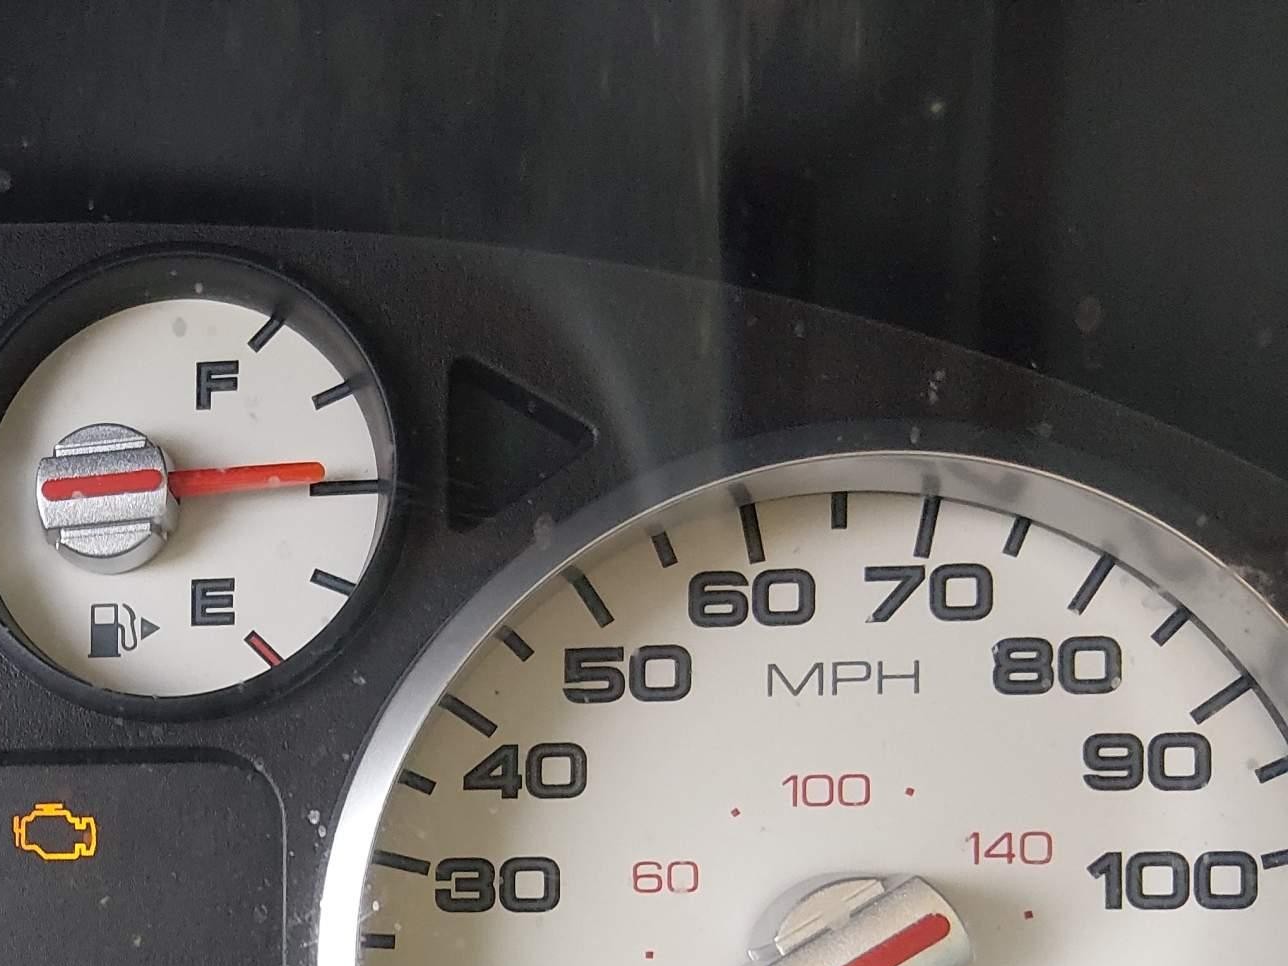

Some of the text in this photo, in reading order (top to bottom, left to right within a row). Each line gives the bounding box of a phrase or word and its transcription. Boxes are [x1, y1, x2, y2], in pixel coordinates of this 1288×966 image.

[196, 361, 238, 409] F
[190, 577, 235, 626] E
[688, 568, 815, 628] 60
[864, 563, 993, 623] 70
[562, 644, 692, 704] 50
[767, 660, 920, 697] MPH
[992, 635, 1123, 695] 80
[463, 742, 587, 799] 40
[1083, 732, 1212, 791] 90
[782, 773, 871, 808] 100
[968, 831, 1053, 865] 140
[435, 856, 561, 913] 30
[632, 861, 699, 893] 60
[1087, 850, 1258, 910] 100
